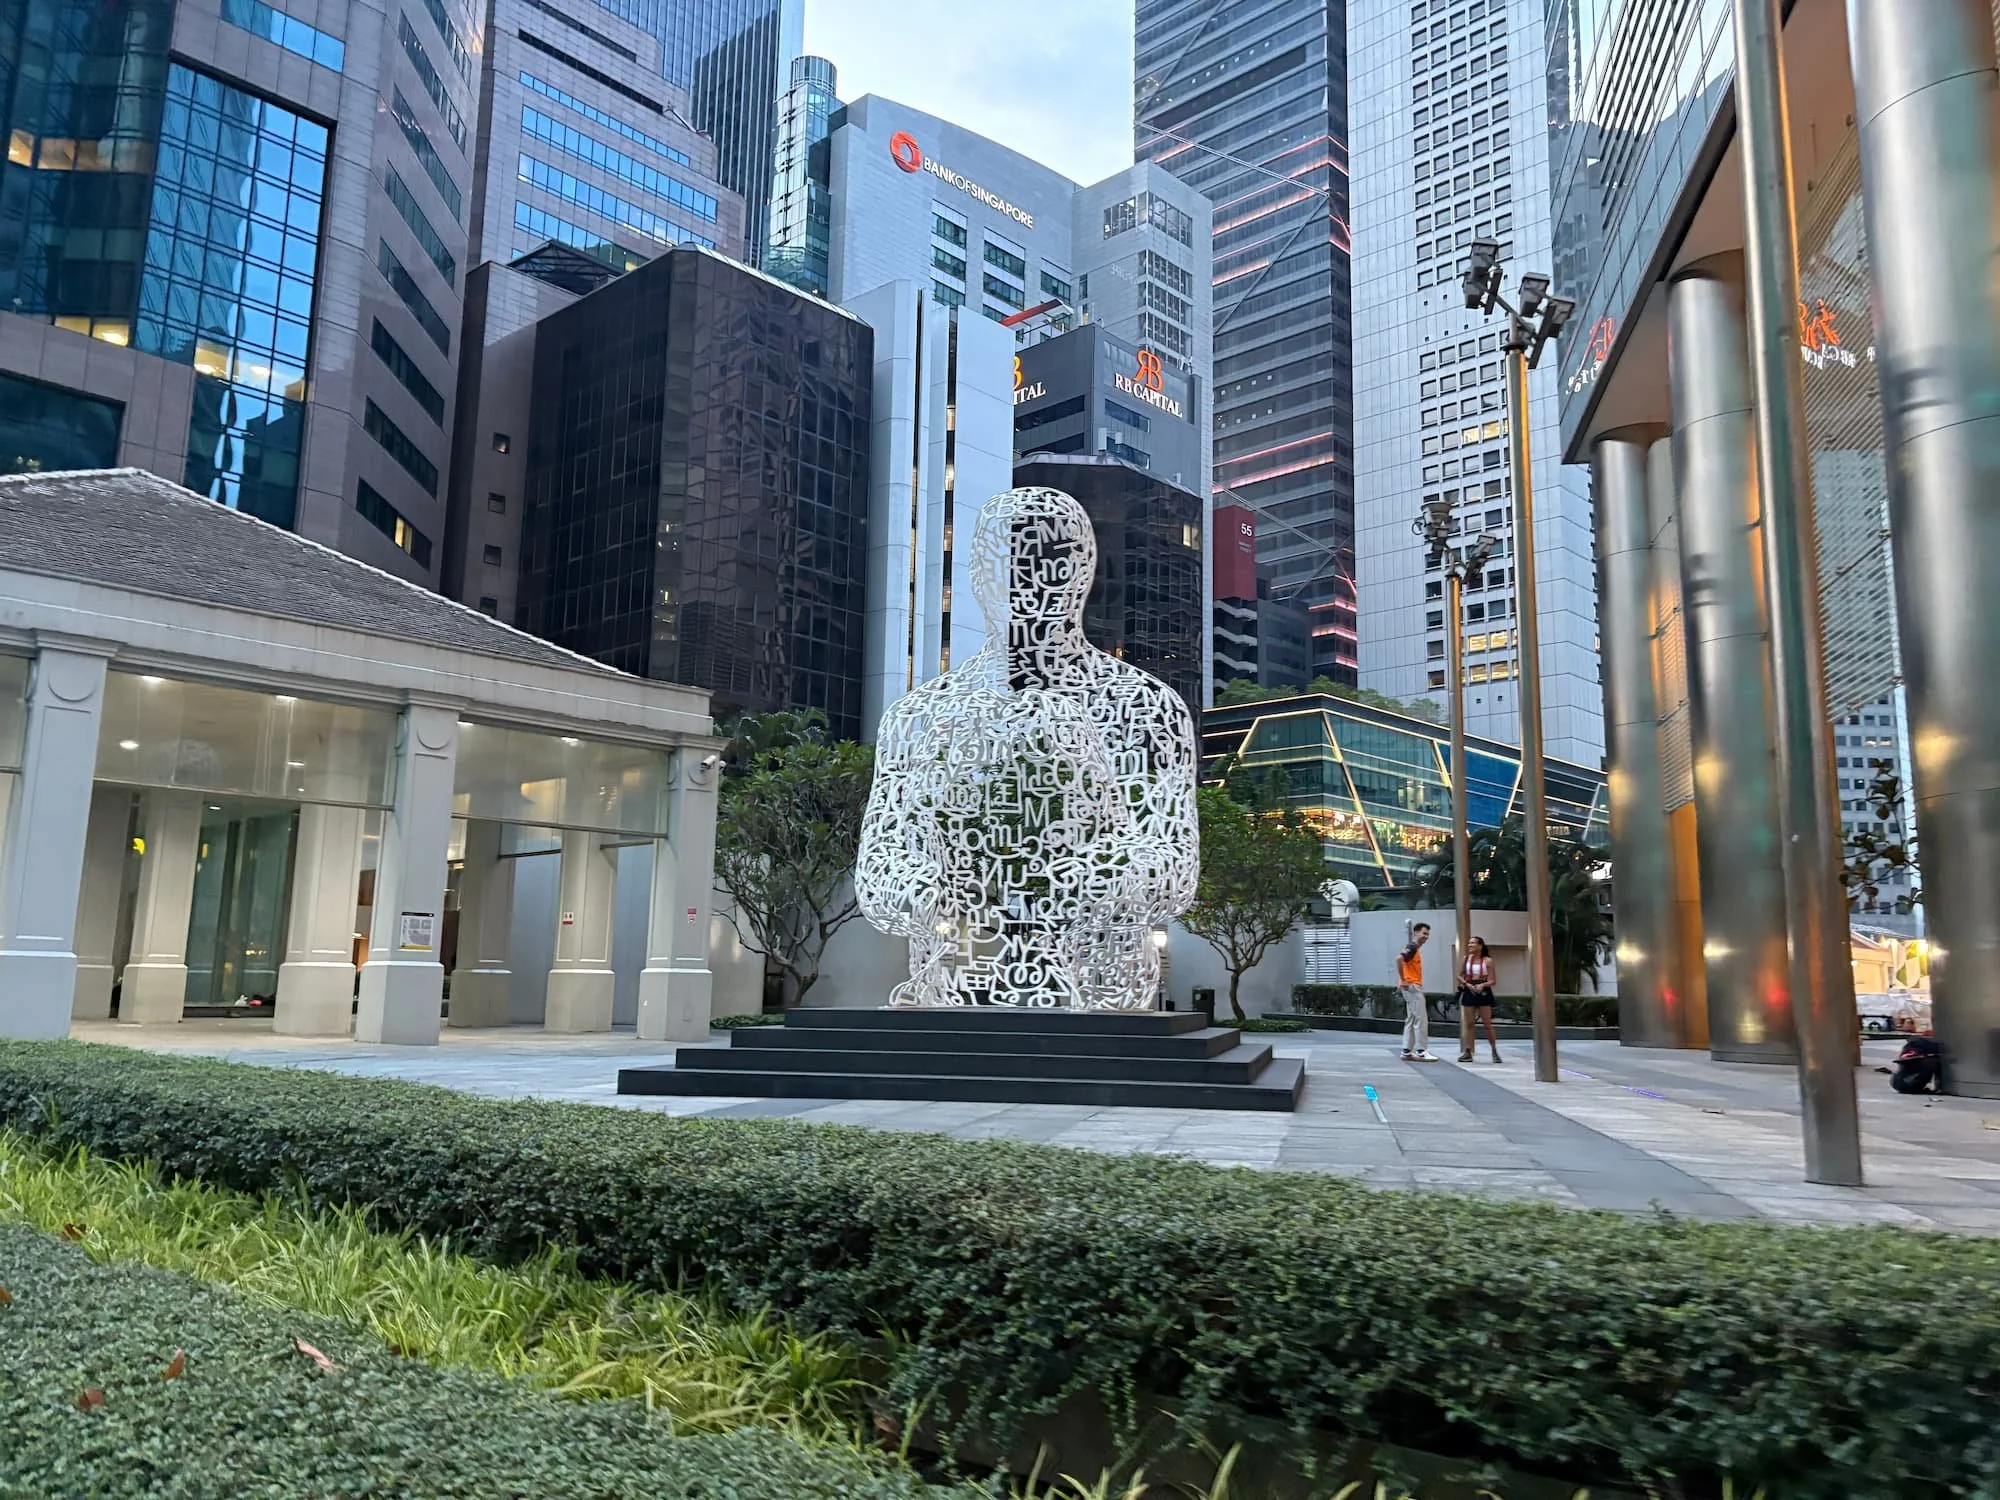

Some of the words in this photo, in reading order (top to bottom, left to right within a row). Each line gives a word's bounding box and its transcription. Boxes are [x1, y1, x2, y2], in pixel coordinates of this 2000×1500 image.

[1013, 382, 1046, 405] ITAL
[1115, 373, 1132, 393] RB
[1133, 383, 1183, 418] CAPITAL
[1241, 523, 1253, 537] 55
